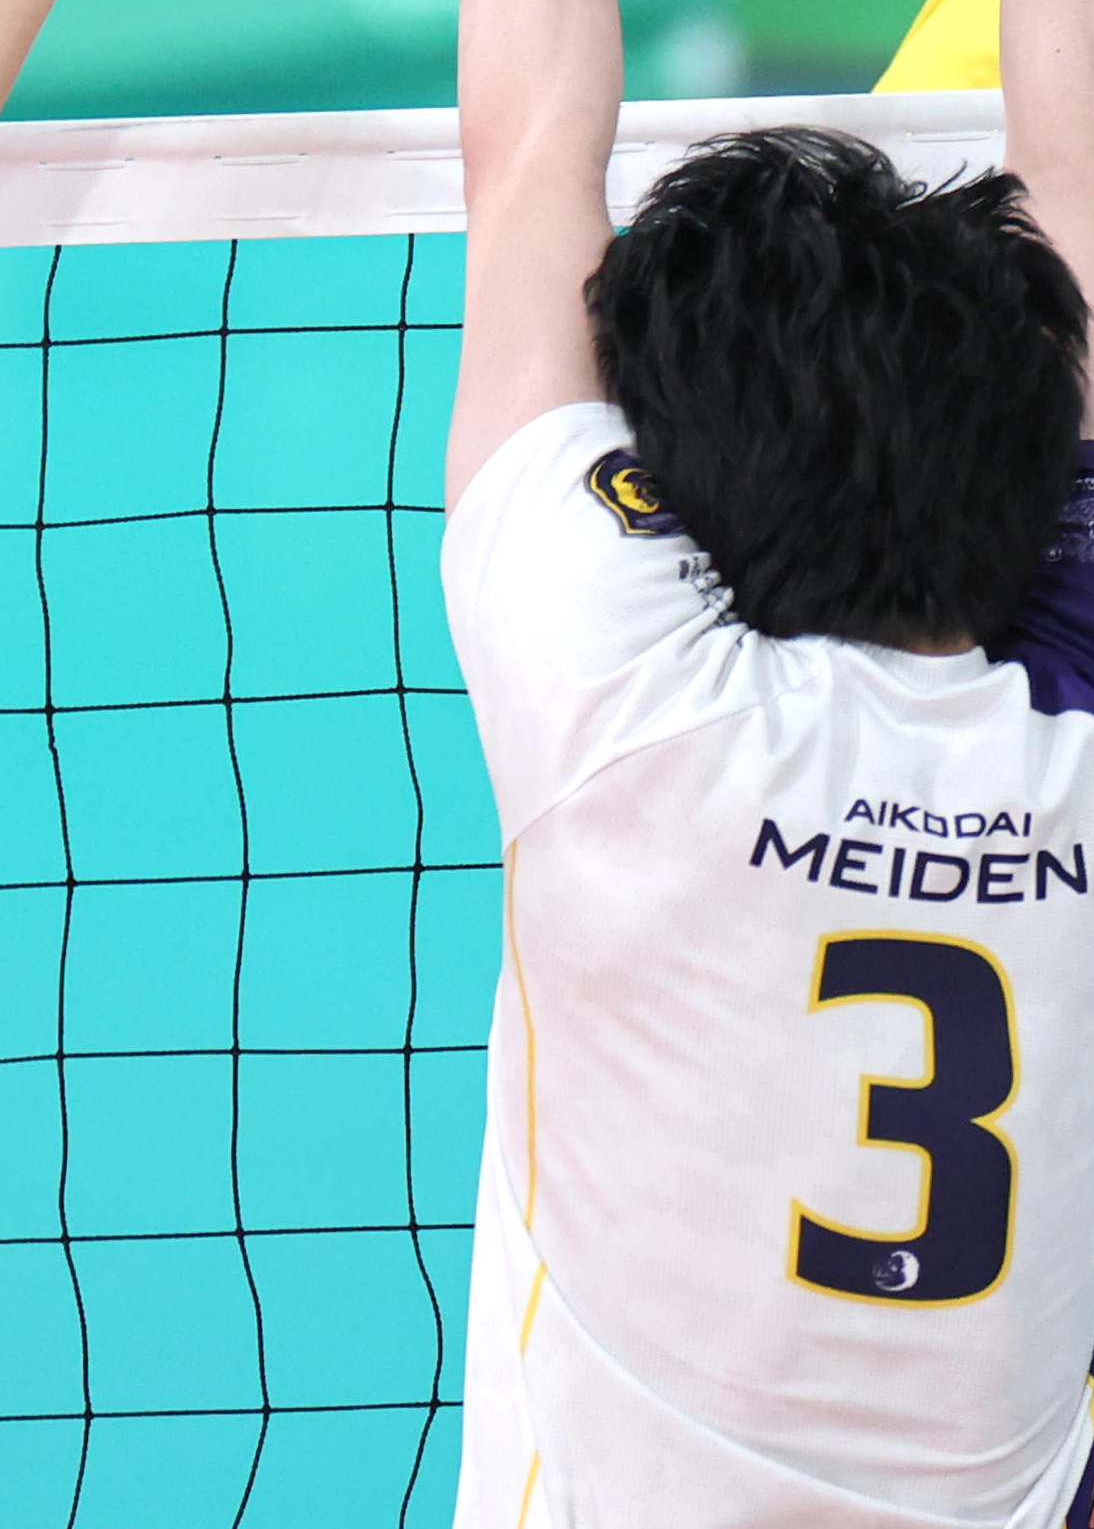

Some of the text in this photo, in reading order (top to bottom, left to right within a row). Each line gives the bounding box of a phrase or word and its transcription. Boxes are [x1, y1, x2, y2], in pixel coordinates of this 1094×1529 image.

[749, 818, 1088, 903] MEIDEN
[843, 798, 1032, 838] AIKODAI
[786, 929, 1021, 1309] 3
